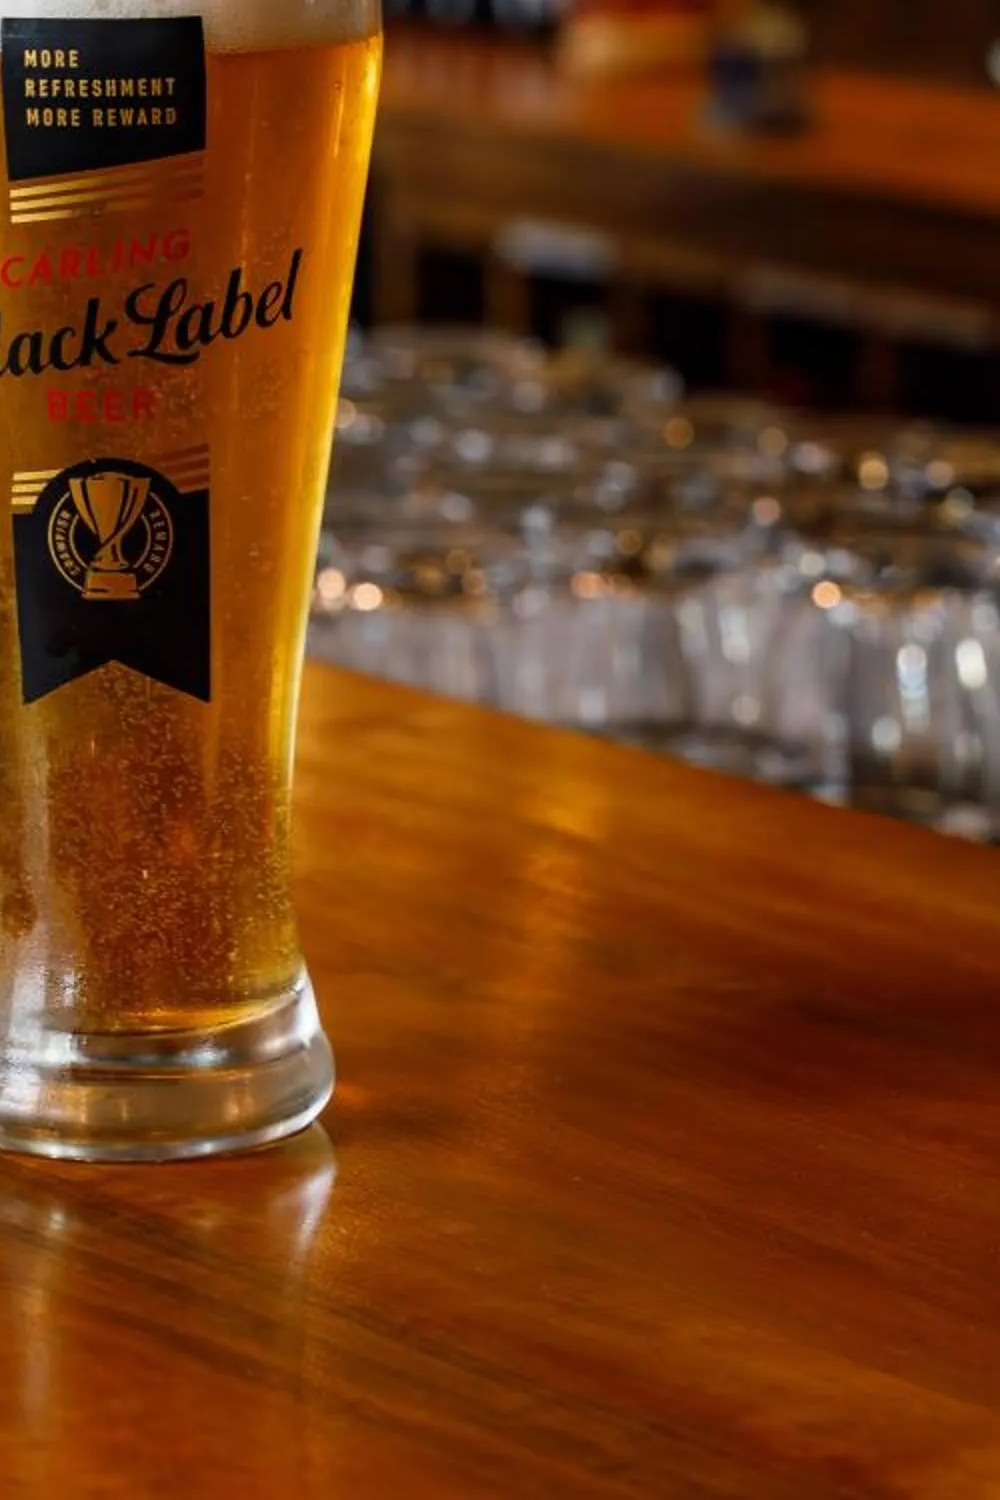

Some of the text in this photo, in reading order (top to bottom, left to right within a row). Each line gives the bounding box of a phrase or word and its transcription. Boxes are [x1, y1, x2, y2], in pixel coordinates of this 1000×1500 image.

[23, 49, 80, 68] MORE
[24, 77, 177, 98] REFRESHMENT
[26, 107, 178, 127] MORE REWARD
[0, 229, 191, 288] CARLING
[125, 247, 302, 366] Label
[46, 389, 156, 423] BEER
